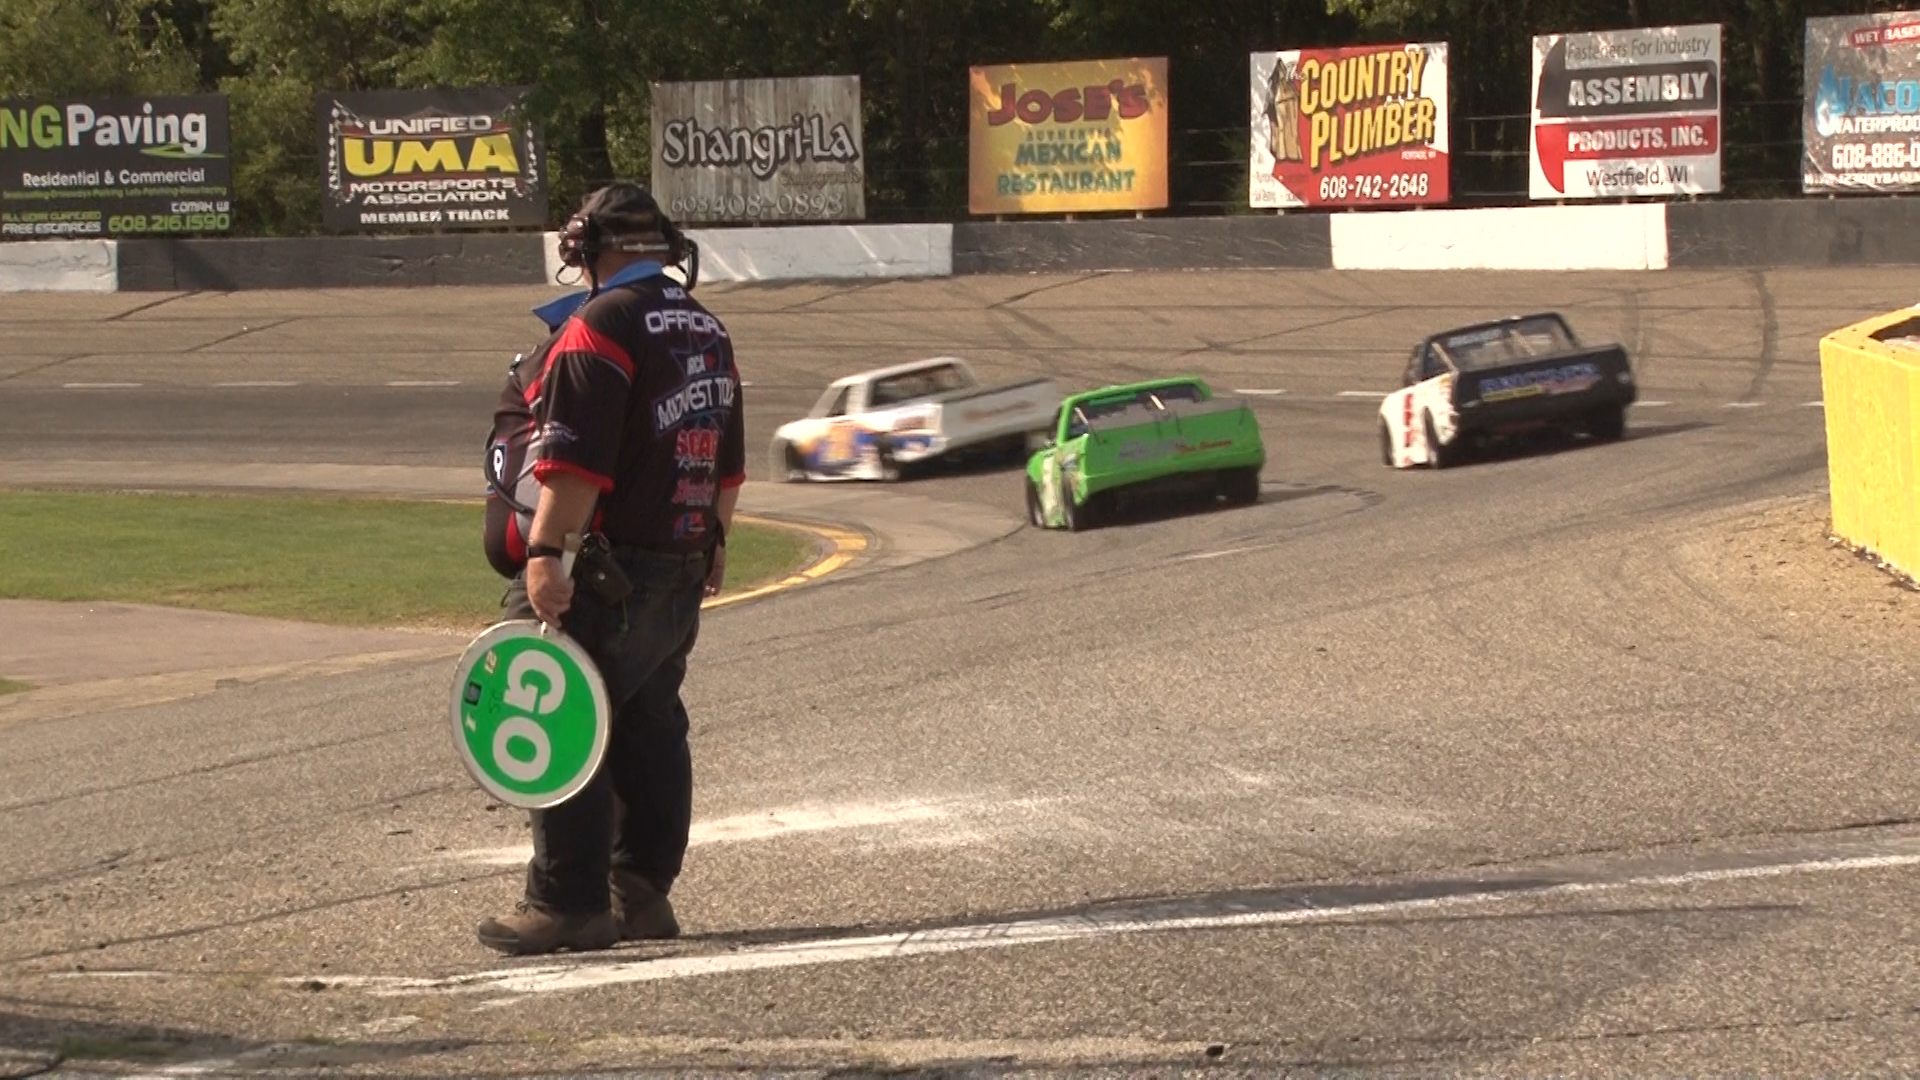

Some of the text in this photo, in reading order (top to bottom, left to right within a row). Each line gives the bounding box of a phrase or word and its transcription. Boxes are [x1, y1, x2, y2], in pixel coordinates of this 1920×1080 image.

[1855, 25, 1920, 45] WET BASE
[1567, 36, 1711, 60] Fasteners For Industry
[1300, 48, 1427, 115] COUNTRY
[1568, 72, 1709, 107] ASSEMBLY
[988, 79, 1150, 126] JOSE'S
[369, 115, 493, 135] UNIFIED
[1310, 97, 1436, 170] PLUMBER
[1671, 125, 1709, 147] INC.
[343, 133, 520, 177] UMA
[662, 113, 860, 181] Shangri-La
[1014, 141, 1122, 168] MEXICAN
[23, 168, 205, 188] Residential & Commercial
[350, 177, 516, 194] MOTORSPORTS
[997, 170, 1136, 195] RESTAURANT
[1586, 165, 1690, 188] Westfield, WI
[362, 190, 507, 206] ASSOCIATION
[108, 213, 230, 233] 608.216.1590
[361, 209, 510, 224] MEMBER TRACK
[493, 649, 566, 782] GO
